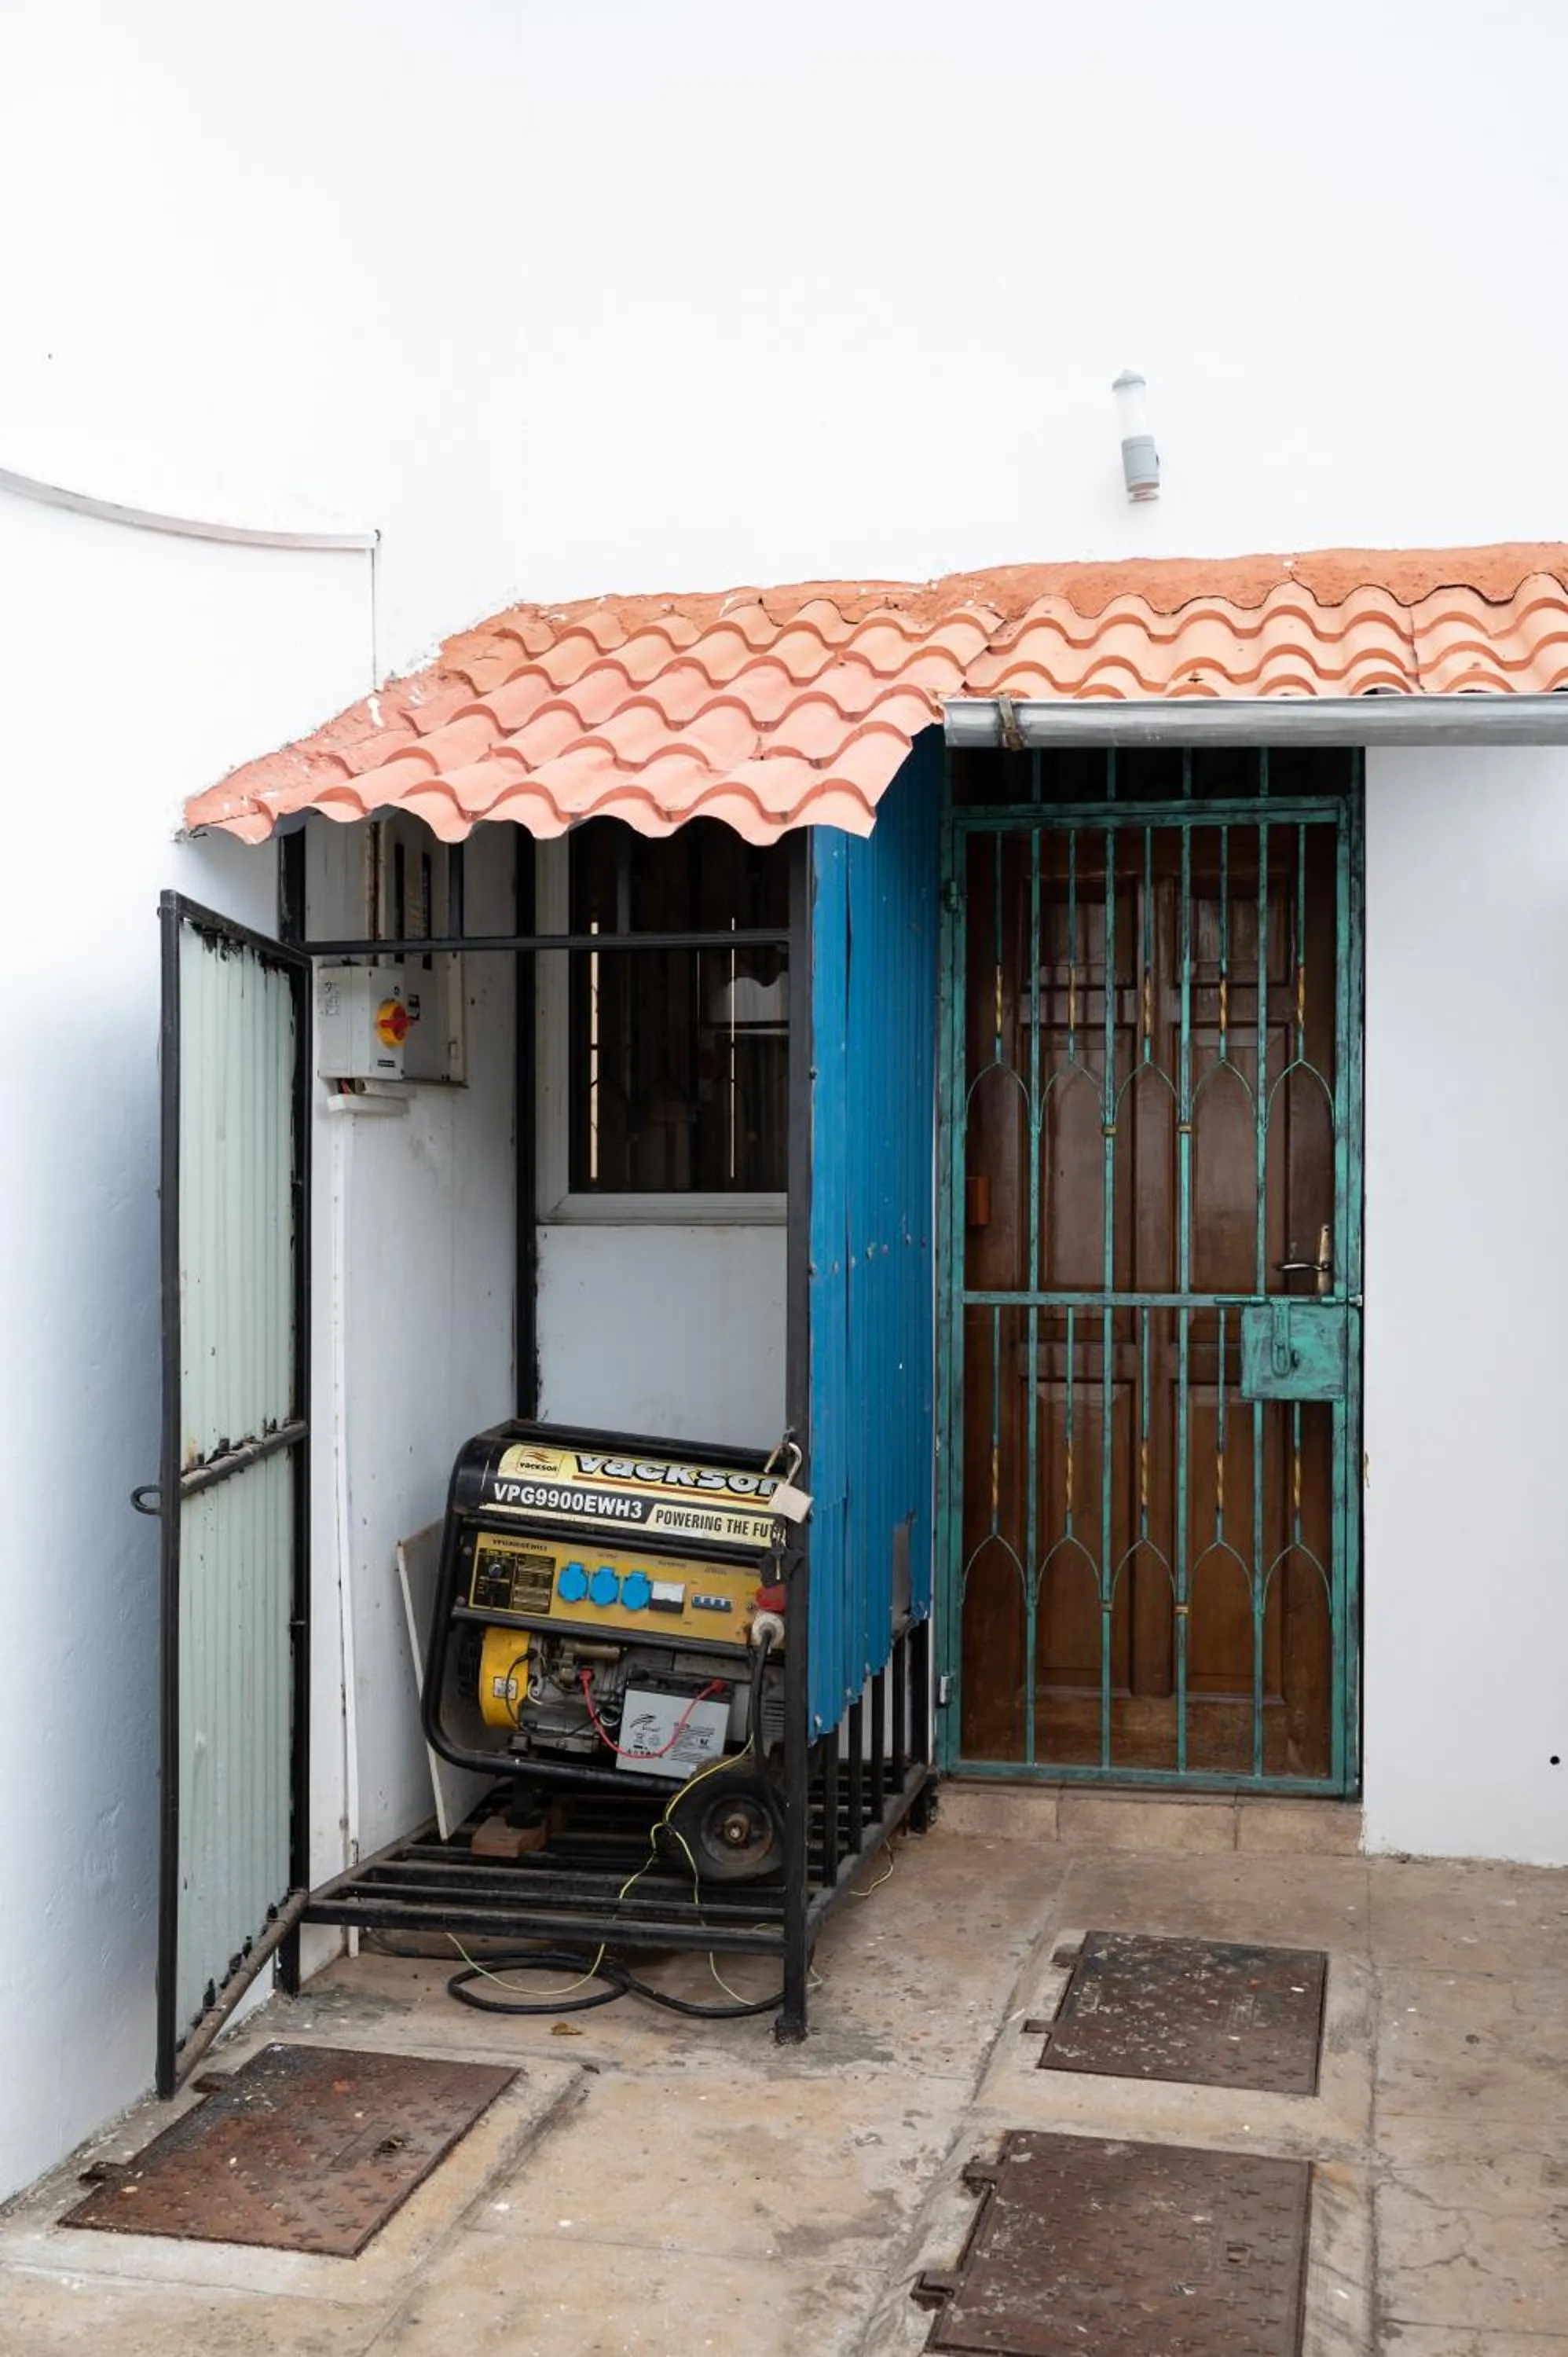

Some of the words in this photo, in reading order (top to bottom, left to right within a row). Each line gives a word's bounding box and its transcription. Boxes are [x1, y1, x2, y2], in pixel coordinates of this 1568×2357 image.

[494, 1483, 642, 1519] VPG9900EWH3
[655, 1509, 722, 1532] POWERING
[727, 1518, 749, 1535] THE
